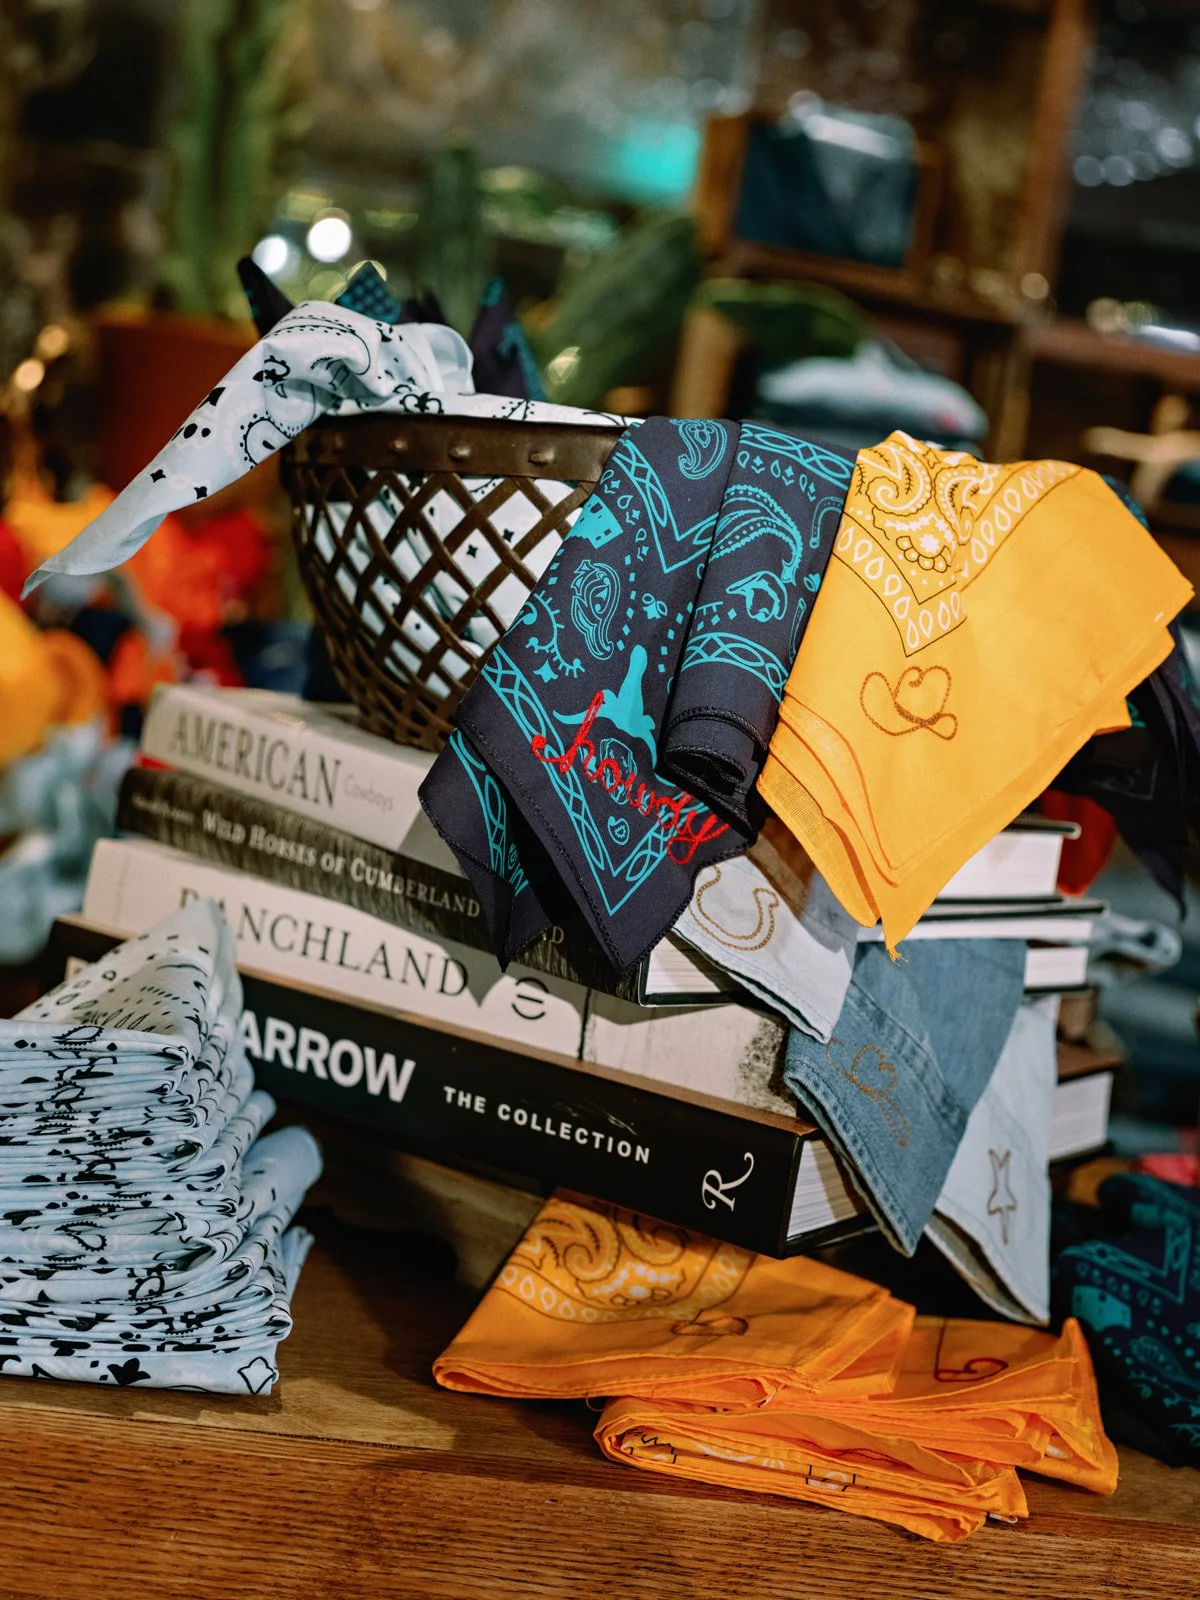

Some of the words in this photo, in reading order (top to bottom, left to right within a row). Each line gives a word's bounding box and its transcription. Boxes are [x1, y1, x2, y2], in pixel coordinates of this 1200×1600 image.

[168, 711, 342, 809] AMERICAN
[531, 691, 729, 865] howdy
[202, 808, 246, 845] WILD
[248, 824, 317, 868] HORSES
[350, 857, 481, 918] CUMBERLAND
[179, 886, 469, 998] NCHLAND
[443, 1085, 487, 1114] THE
[497, 1103, 651, 1165] COLLECTION
[701, 1151, 756, 1213] R
